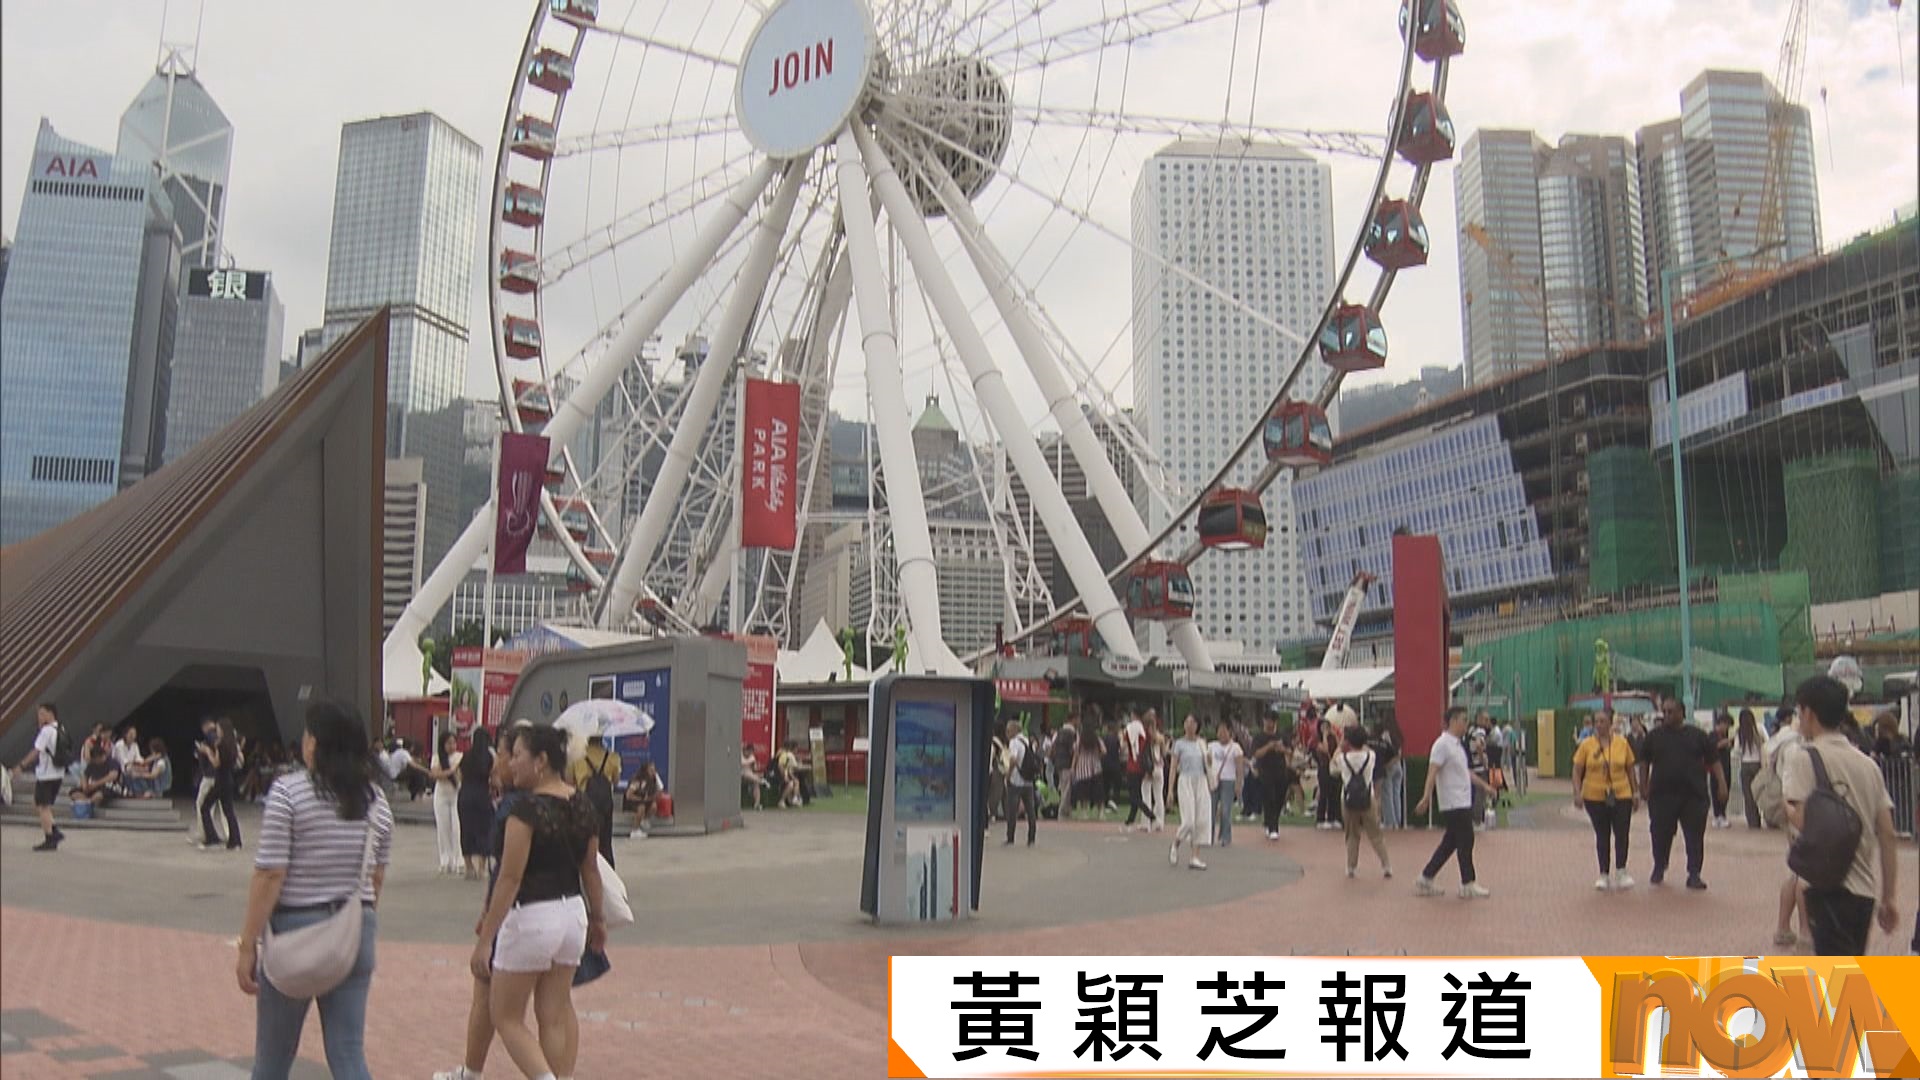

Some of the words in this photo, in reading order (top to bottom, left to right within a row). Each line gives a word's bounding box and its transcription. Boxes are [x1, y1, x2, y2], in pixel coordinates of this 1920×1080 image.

[769, 37, 833, 96] JOIN
[46, 156, 97, 177] AIA
[207, 270, 247, 301] 銀
[751, 427, 767, 490] PARK
[771, 418, 788, 462] AIA
